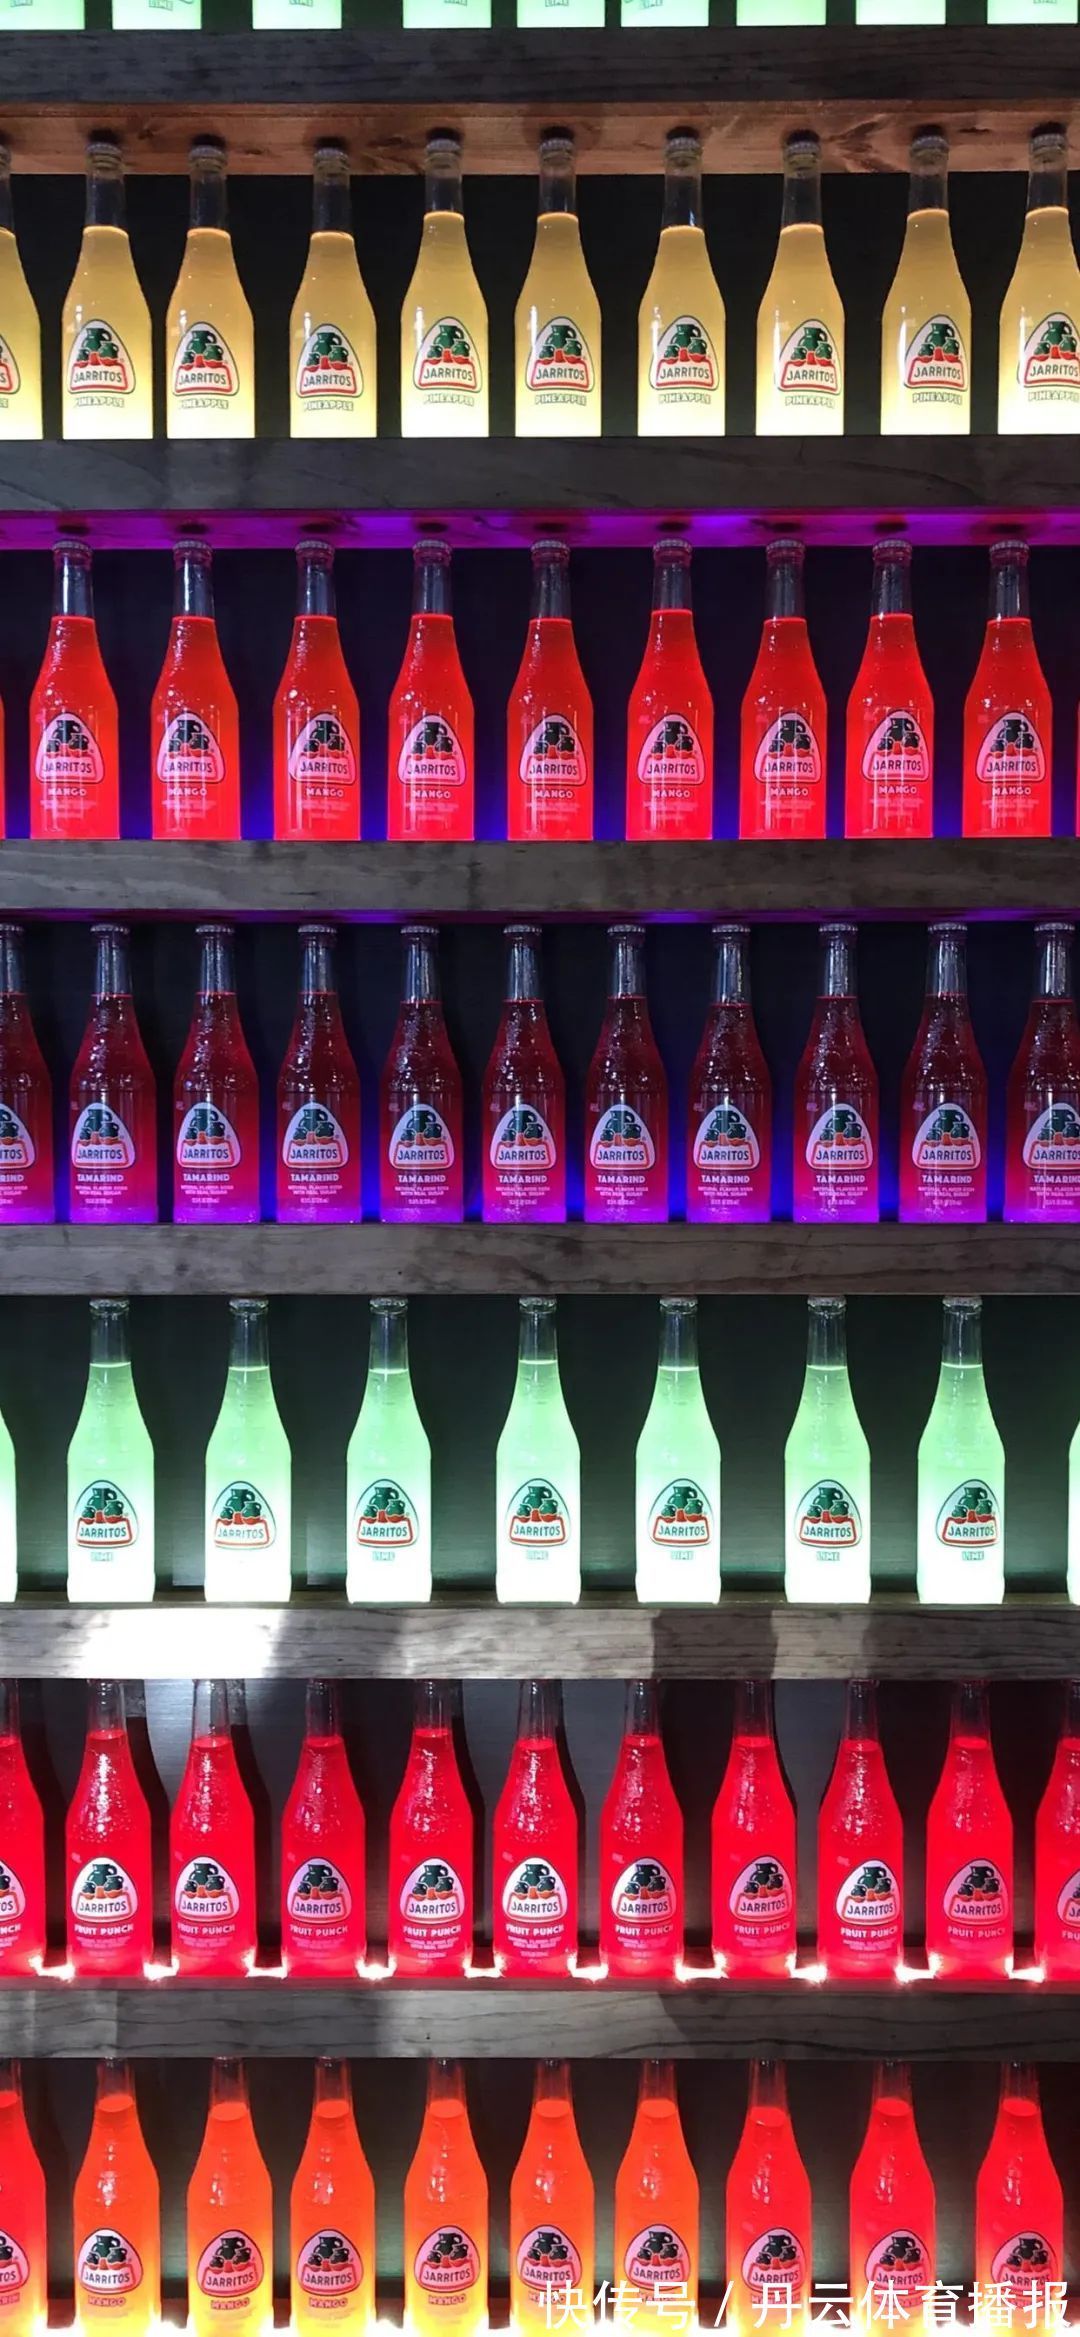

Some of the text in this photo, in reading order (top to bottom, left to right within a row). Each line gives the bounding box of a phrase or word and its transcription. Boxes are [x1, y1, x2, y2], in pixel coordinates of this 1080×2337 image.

[74, 370, 122, 382] JARRITOS
[424, 366, 472, 380] JARRITOS
[536, 367, 584, 380] JARRITOS
[660, 367, 709, 379] JARRITOS
[787, 370, 834, 383] JARRITOS
[914, 366, 961, 380] JARRITOS
[1030, 364, 1078, 377] JARRITOS
[179, 373, 227, 385] JARRITOS
[304, 374, 351, 387] JARRITOS
[45, 761, 92, 774] JARRITOS
[164, 760, 213, 773] JARRITOS
[300, 761, 348, 774] JARRITOS
[407, 763, 456, 776] JARRITOS
[529, 763, 577, 775] JARRITOS
[646, 763, 696, 775] JARRITOS
[765, 761, 813, 773] JARRITOS
[873, 760, 921, 772] JARRITOS
[987, 760, 1036, 772] JARRITOS
[47, 788, 86, 797] MANGO
[169, 788, 207, 796] MANGO
[306, 787, 344, 797] MANGO
[413, 790, 451, 799] MANGO
[535, 789, 573, 798] MANGO
[652, 789, 690, 798] MANGO
[770, 787, 809, 796] MANGO
[879, 786, 917, 794] MANGO
[992, 786, 1031, 796] MANGO
[77, 1149, 122, 1160] JARRITOS
[183, 1149, 229, 1160] JARRITOS
[290, 1149, 337, 1160] JARRITOS
[397, 1150, 445, 1161] JARRITOS
[499, 1150, 545, 1161] JARRITOS
[598, 1150, 645, 1161] JARRITOS
[701, 1150, 749, 1161] JARRITOS
[816, 1150, 864, 1161] JARRITOS
[922, 1150, 971, 1161] JARRITOS
[77, 1174, 123, 1183] TAMARIND
[183, 1174, 230, 1182] TAMARIND
[291, 1174, 339, 1182] TAMARIND
[398, 1175, 446, 1184] TAMARIND
[499, 1175, 547, 1184] TAMARIND
[597, 1175, 645, 1183] TAMARIND
[701, 1175, 750, 1184] TAMARIND
[816, 1175, 865, 1184] TAMARIND
[922, 1175, 972, 1184] TAMARIND
[80, 1527, 127, 1539] JARRITOS
[217, 1528, 264, 1540] JARRITOS
[361, 1526, 408, 1537] JARRITOS
[514, 1526, 560, 1537] JARRITOS
[658, 1526, 705, 1537] JARRITOS
[804, 1527, 851, 1538] JARRITOS
[948, 1525, 994, 1537] JARRITOS
[80, 1901, 126, 1913] JARRITOS
[181, 1901, 228, 1913] JARRITOS
[294, 1902, 341, 1914] JARRITOS
[409, 1902, 455, 1914] JARRITOS
[511, 1901, 558, 1913] JARRITOS
[621, 1900, 668, 1913] JARRITOS
[740, 1900, 786, 1912] JARRITOS
[847, 1903, 893, 1915] JARRITOS
[954, 1902, 1000, 1915] JARRITOS
[75, 1924, 97, 1935] FRUIT
[178, 1925, 198, 1935] FRUIT
[291, 1925, 312, 1935] FRUIT
[403, 1926, 426, 1936] FRUIT
[506, 1924, 528, 1935] FRUIT
[615, 1924, 640, 1935] FRUIT
[734, 1925, 758, 1936] FRUIT
[841, 1926, 866, 1938] FRUIT
[948, 1926, 973, 1938] FRUIT
[84, 2272, 130, 2284] JARRITOS
[304, 2272, 351, 2286] JARRITOS
[424, 2268, 470, 2282] JARRITOS
[525, 2266, 570, 2281] JARRITOS
[633, 2266, 680, 2280] JARRITOS
[752, 2270, 798, 2283] JARRITOS
[206, 2272, 254, 2287] JARRITOS
